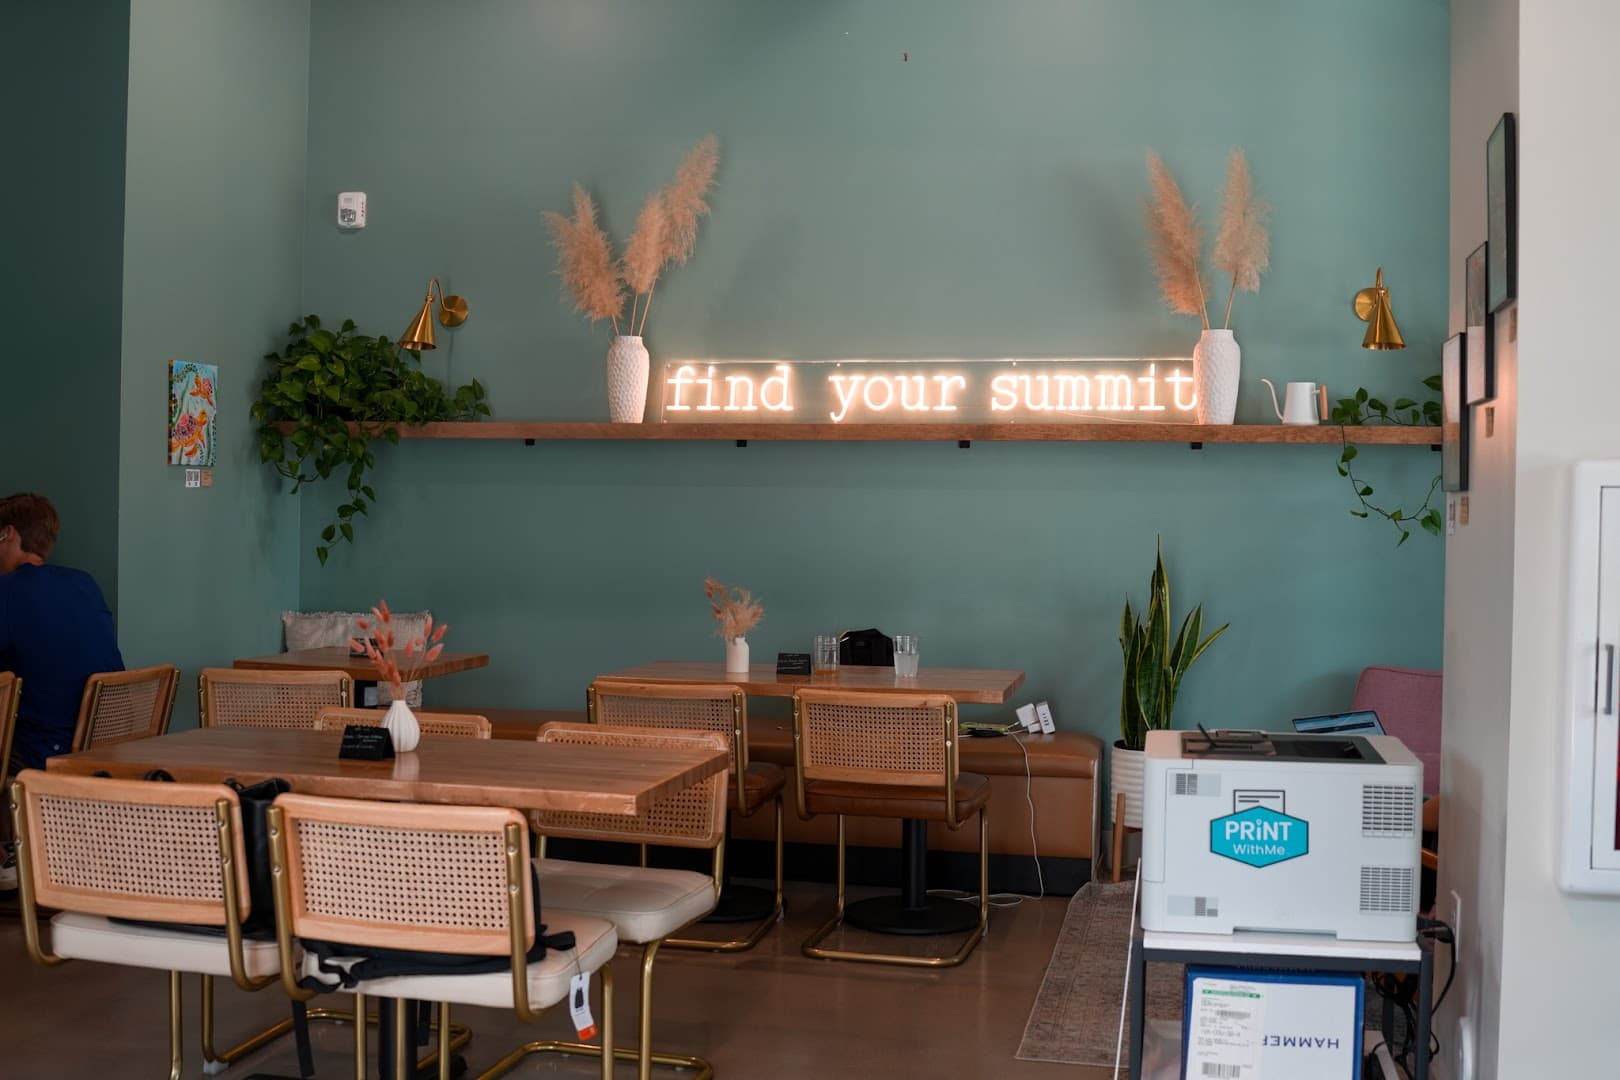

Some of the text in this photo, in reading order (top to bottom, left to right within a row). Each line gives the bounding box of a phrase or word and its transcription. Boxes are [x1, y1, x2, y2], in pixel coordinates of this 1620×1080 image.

[666, 363, 1198, 422] find your summit
[1232, 843, 1286, 856] WithMe
